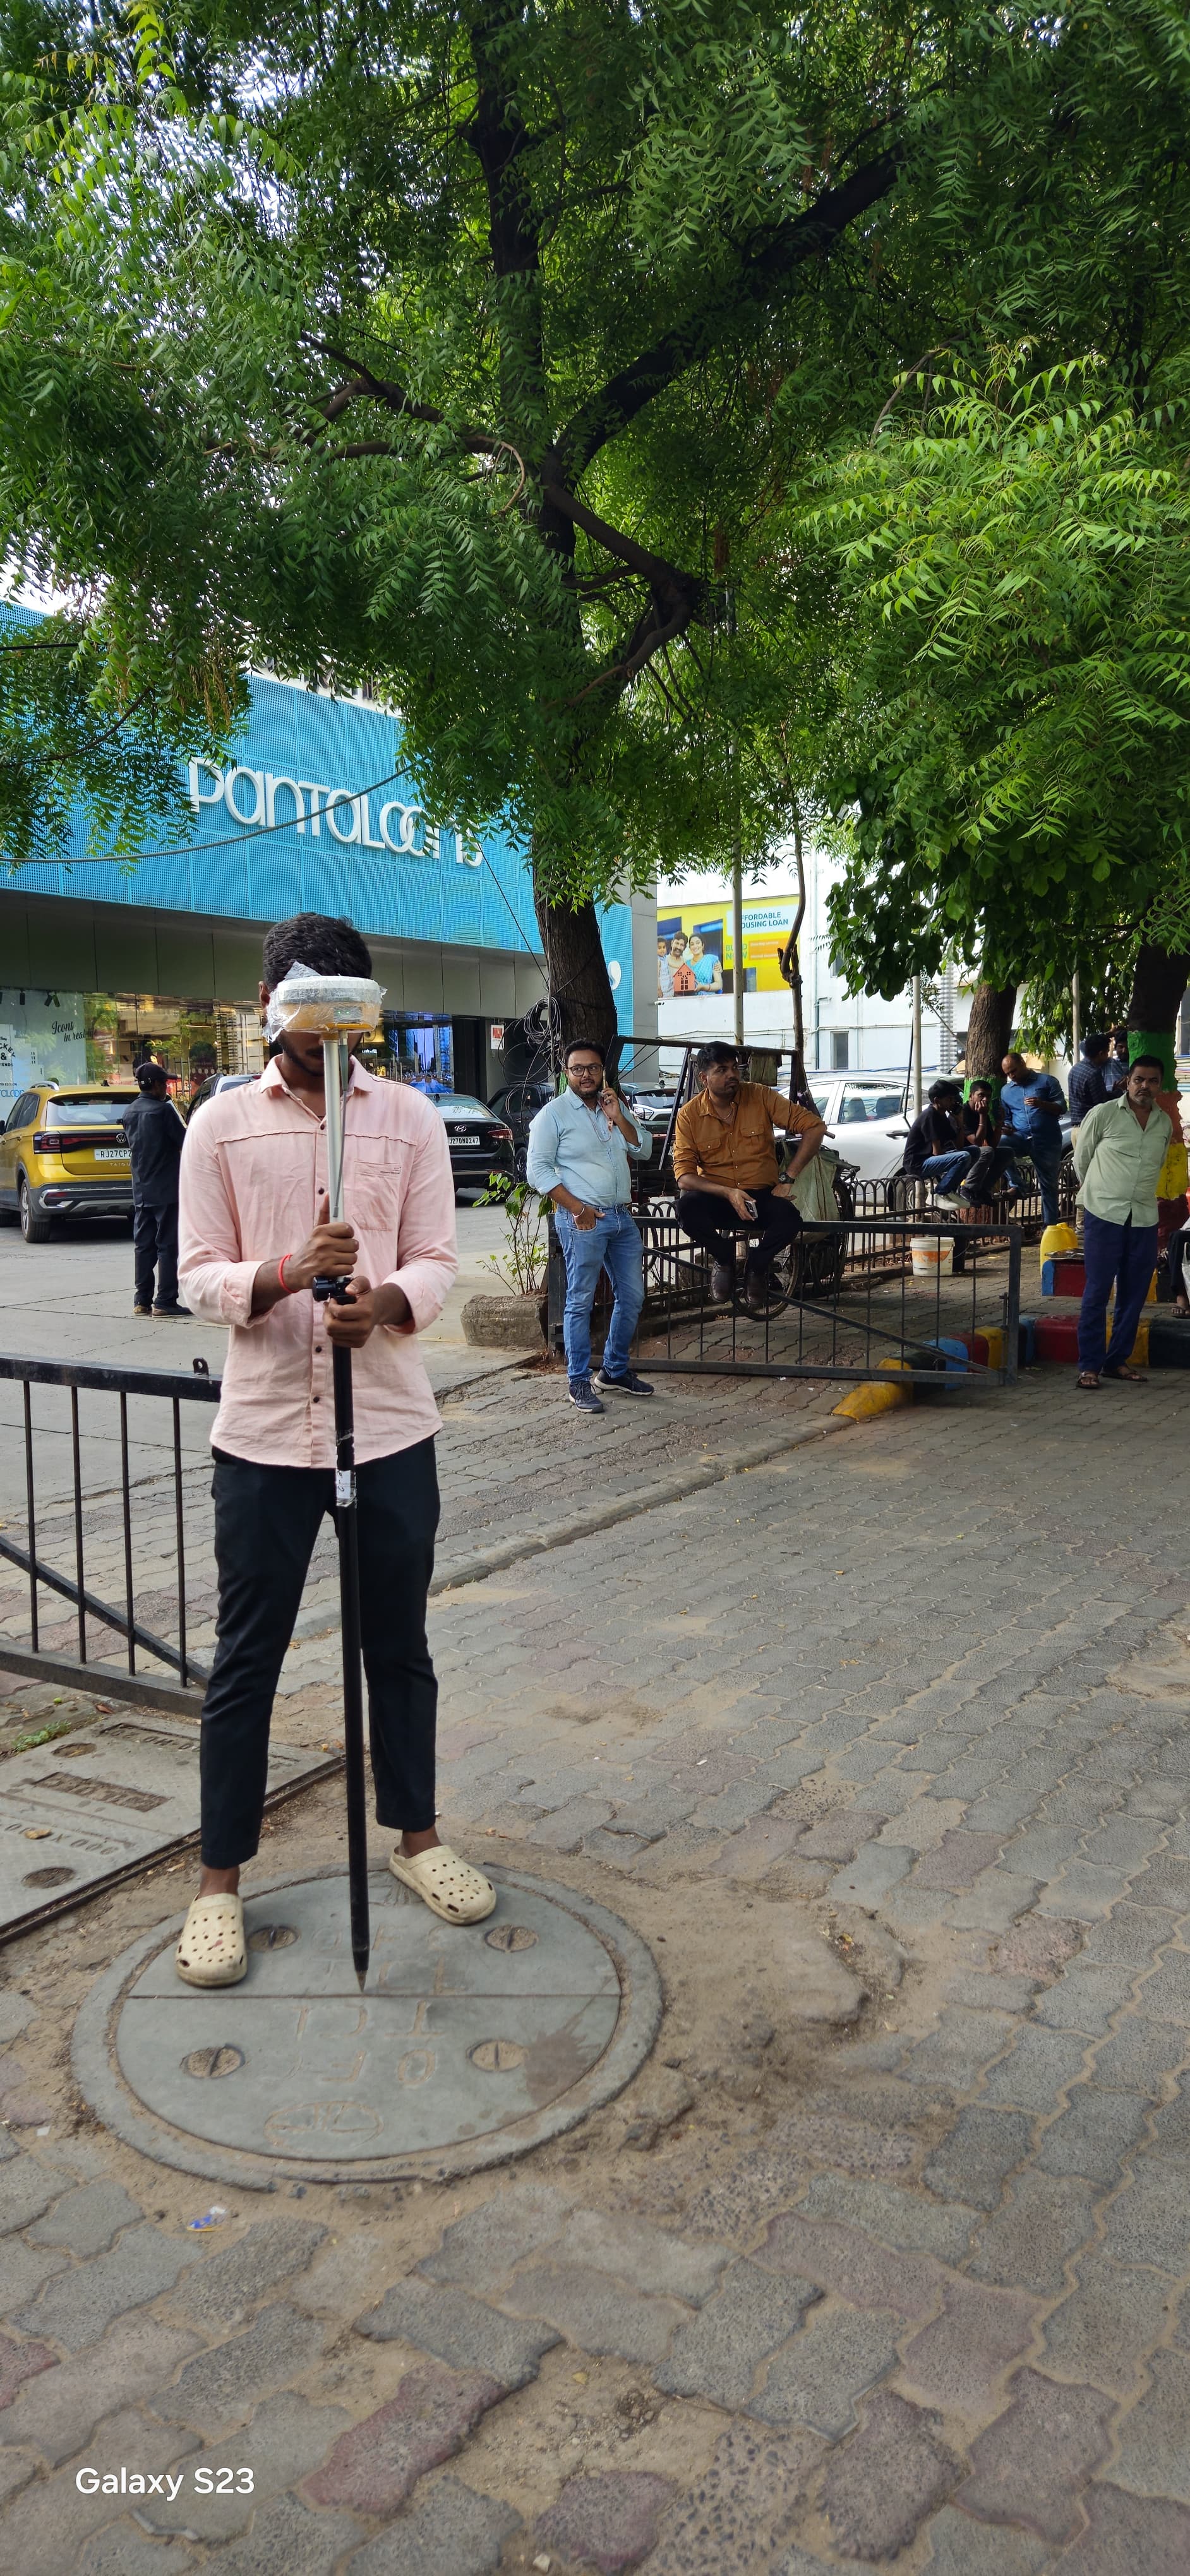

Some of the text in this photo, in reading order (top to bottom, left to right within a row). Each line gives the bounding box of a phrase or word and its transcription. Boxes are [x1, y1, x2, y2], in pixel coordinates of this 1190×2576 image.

[741, 912, 781, 921] FFORDABLE
[742, 921, 767, 929] OUSING
[52, 1021, 74, 1035] Icons
[64, 1033, 71, 1042] in
[100, 1150, 131, 1159] RJ27CP2
